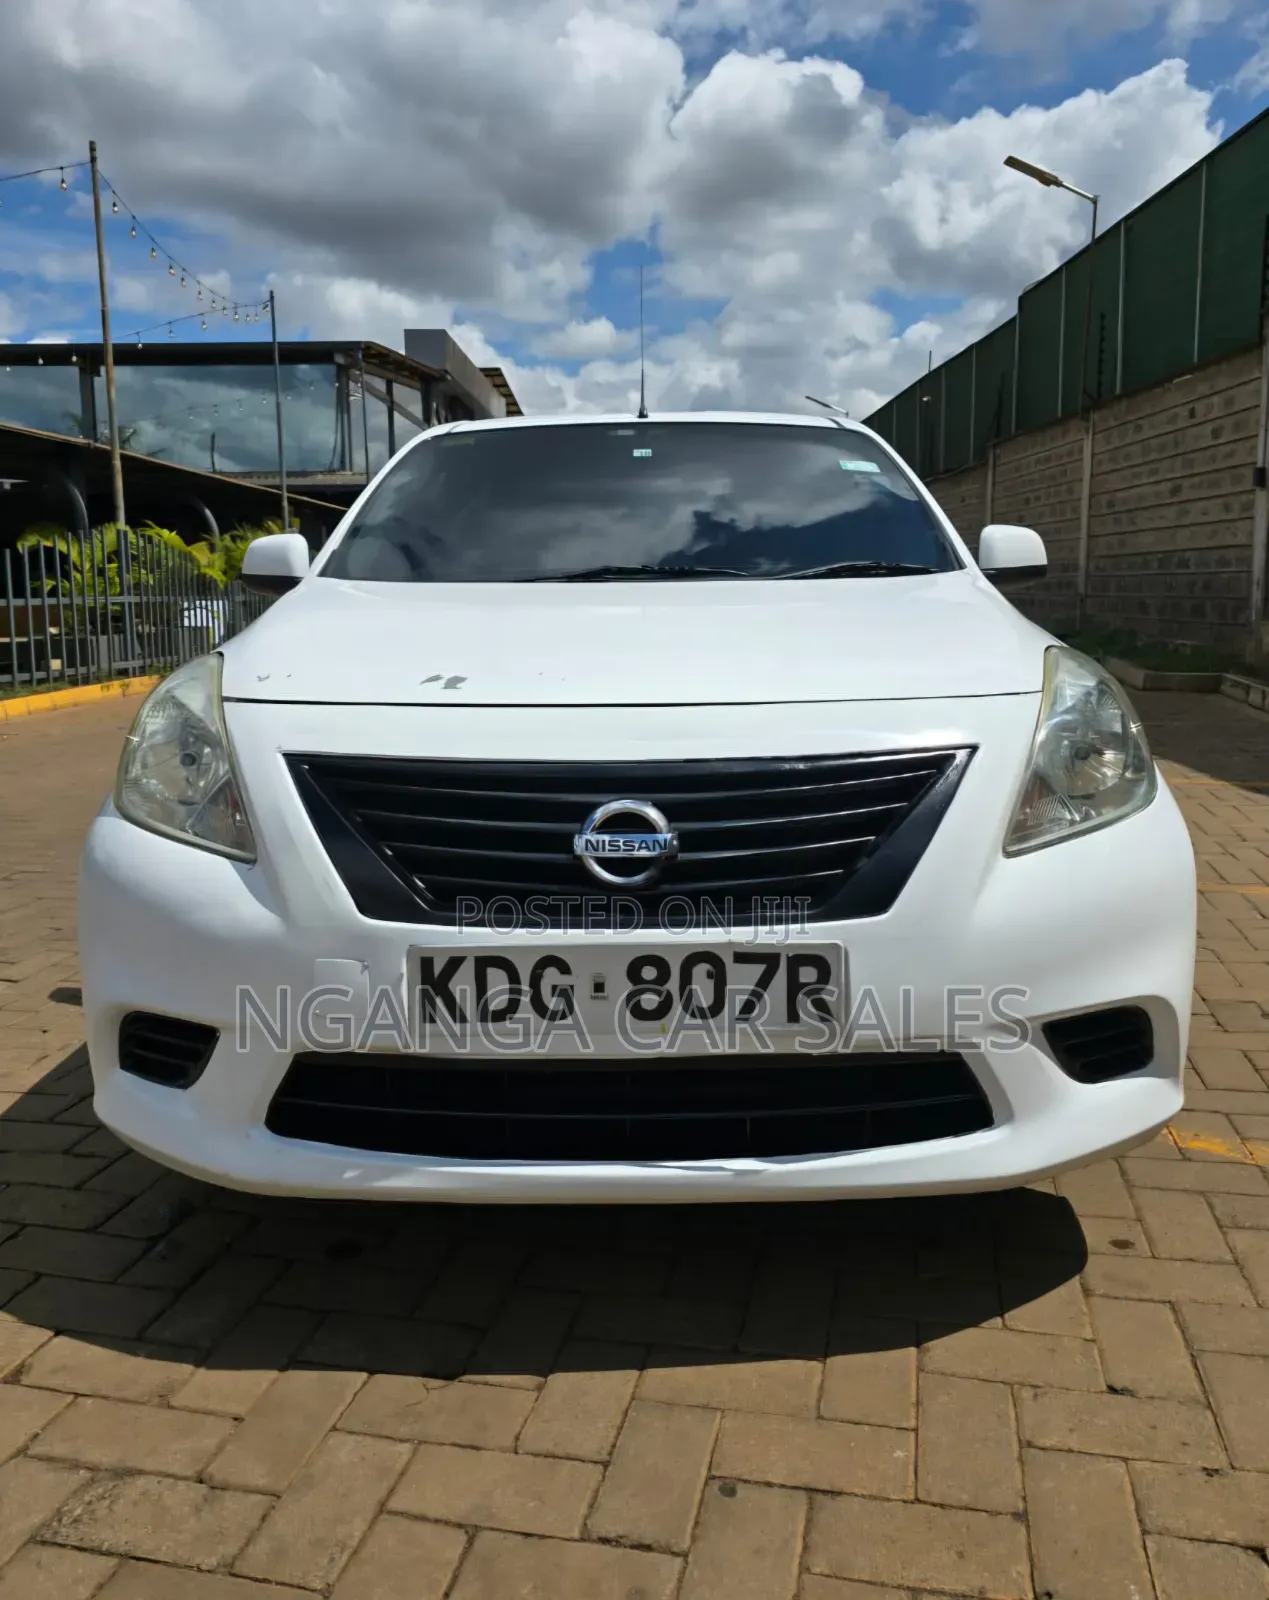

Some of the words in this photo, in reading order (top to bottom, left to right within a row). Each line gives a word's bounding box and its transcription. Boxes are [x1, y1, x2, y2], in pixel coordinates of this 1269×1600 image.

[584, 838, 668, 853] NISSAN
[419, 954, 576, 1024] KDG
[626, 950, 838, 1024] 807R
